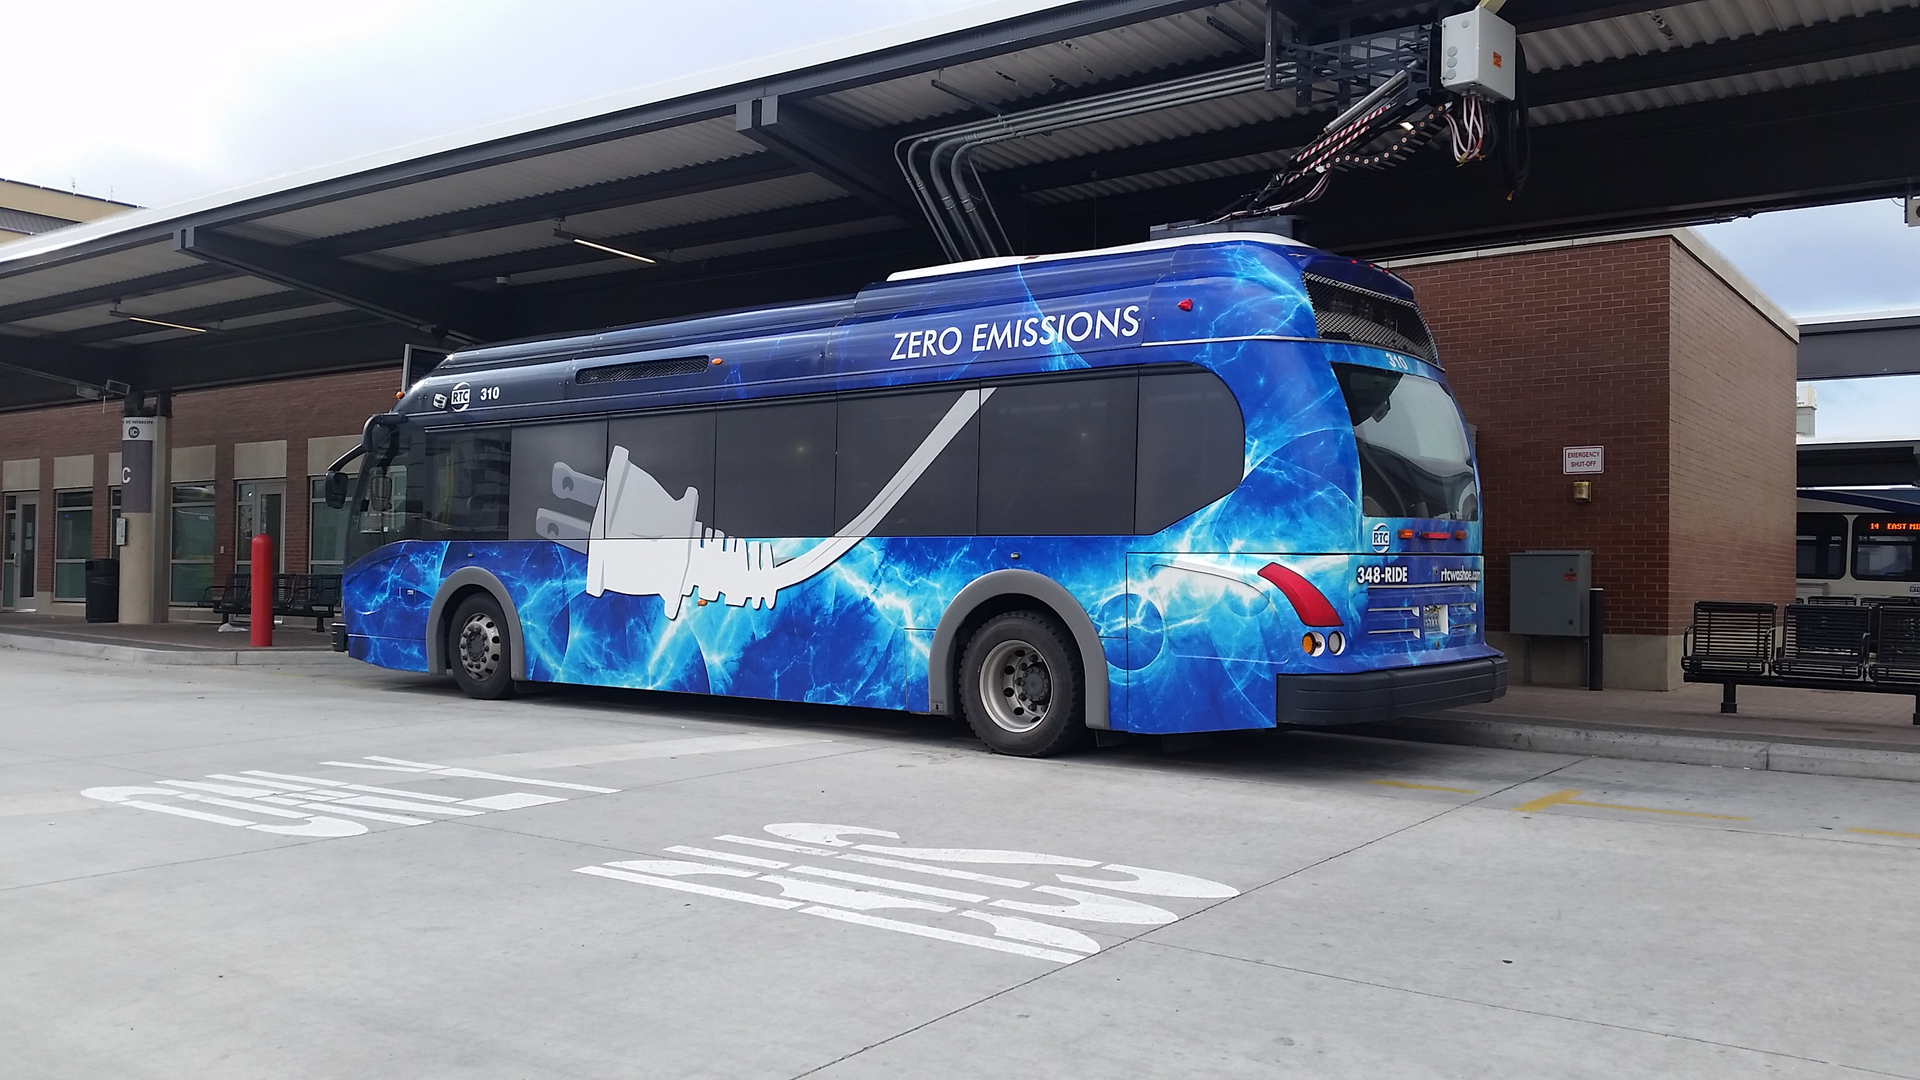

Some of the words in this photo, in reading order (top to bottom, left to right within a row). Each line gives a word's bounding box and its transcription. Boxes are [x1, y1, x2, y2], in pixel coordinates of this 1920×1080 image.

[890, 326, 962, 361] ZERO
[972, 305, 1140, 352] EMISSIONS
[1385, 352, 1408, 371] 310
[452, 391, 469, 403] RTC
[480, 386, 500, 401] 310
[122, 466, 131, 484] C
[1870, 522, 1880, 530] 14
[1887, 522, 1907, 530] EAST
[1373, 532, 1389, 544] RTC
[1357, 566, 1408, 584] 348-RIDE
[1440, 565, 1482, 582] rtcwashoe.com
[80, 755, 622, 837] ONLY
[572, 822, 1241, 964] BUS
